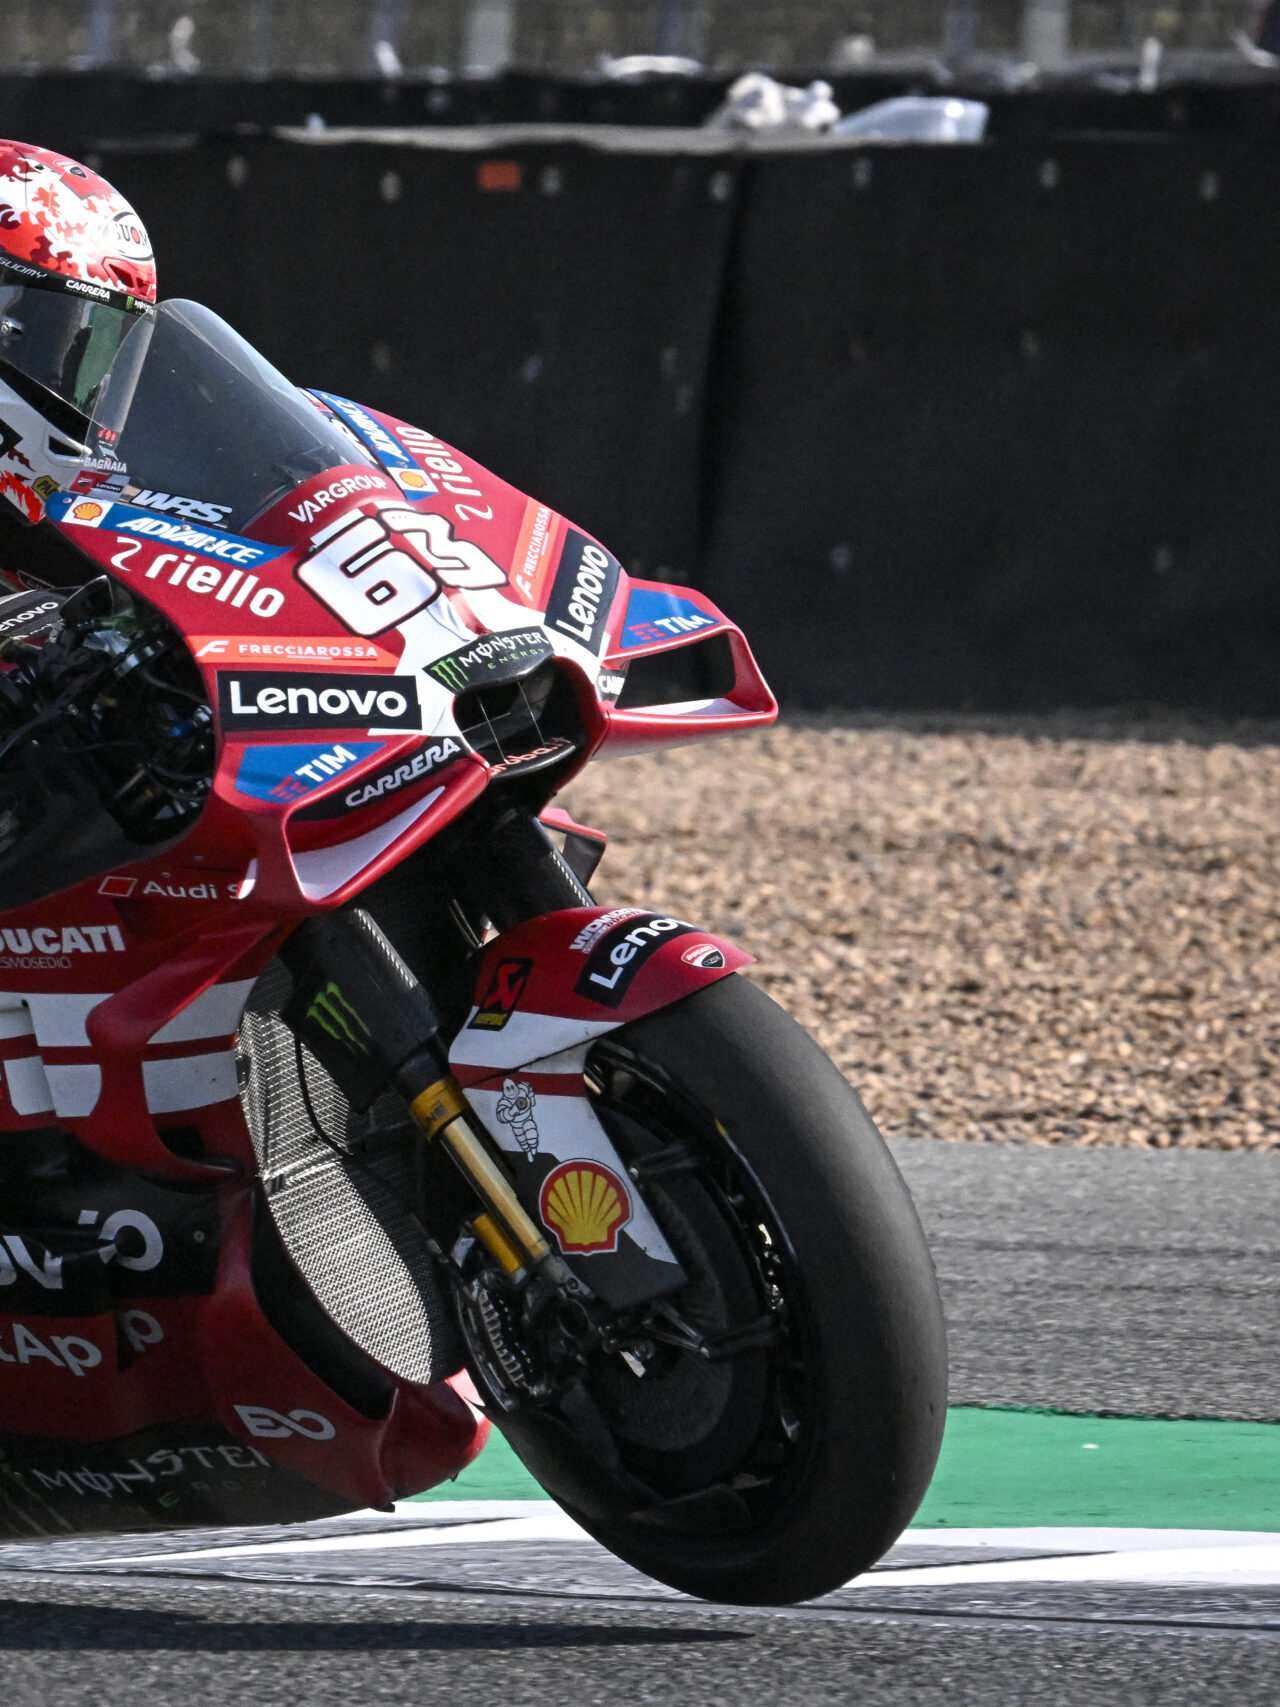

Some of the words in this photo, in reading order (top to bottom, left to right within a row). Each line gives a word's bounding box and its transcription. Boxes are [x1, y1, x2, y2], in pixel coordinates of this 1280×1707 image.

[65, 279, 111, 300] CARRERA
[83, 457, 127, 473] BAGNAIA
[395, 426, 483, 497] riello
[131, 489, 233, 523] WRS
[288, 475, 388, 524] VARGROUP
[116, 517, 264, 563] ADVANCE
[523, 506, 551, 577] FRECCIAROSSA
[144, 553, 285, 618] riello
[292, 507, 510, 639] 63
[556, 545, 609, 642] Lenovo
[654, 615, 714, 634] TIM
[238, 644, 378, 657] FRECCIAROSSA
[458, 631, 550, 668] MONSTER
[487, 648, 546, 670] ENERGY
[229, 680, 408, 718] Lenovo
[295, 744, 358, 783] TIM
[345, 737, 461, 807] CARRERA
[143, 880, 218, 900] Audi
[589, 917, 697, 990] Leno
